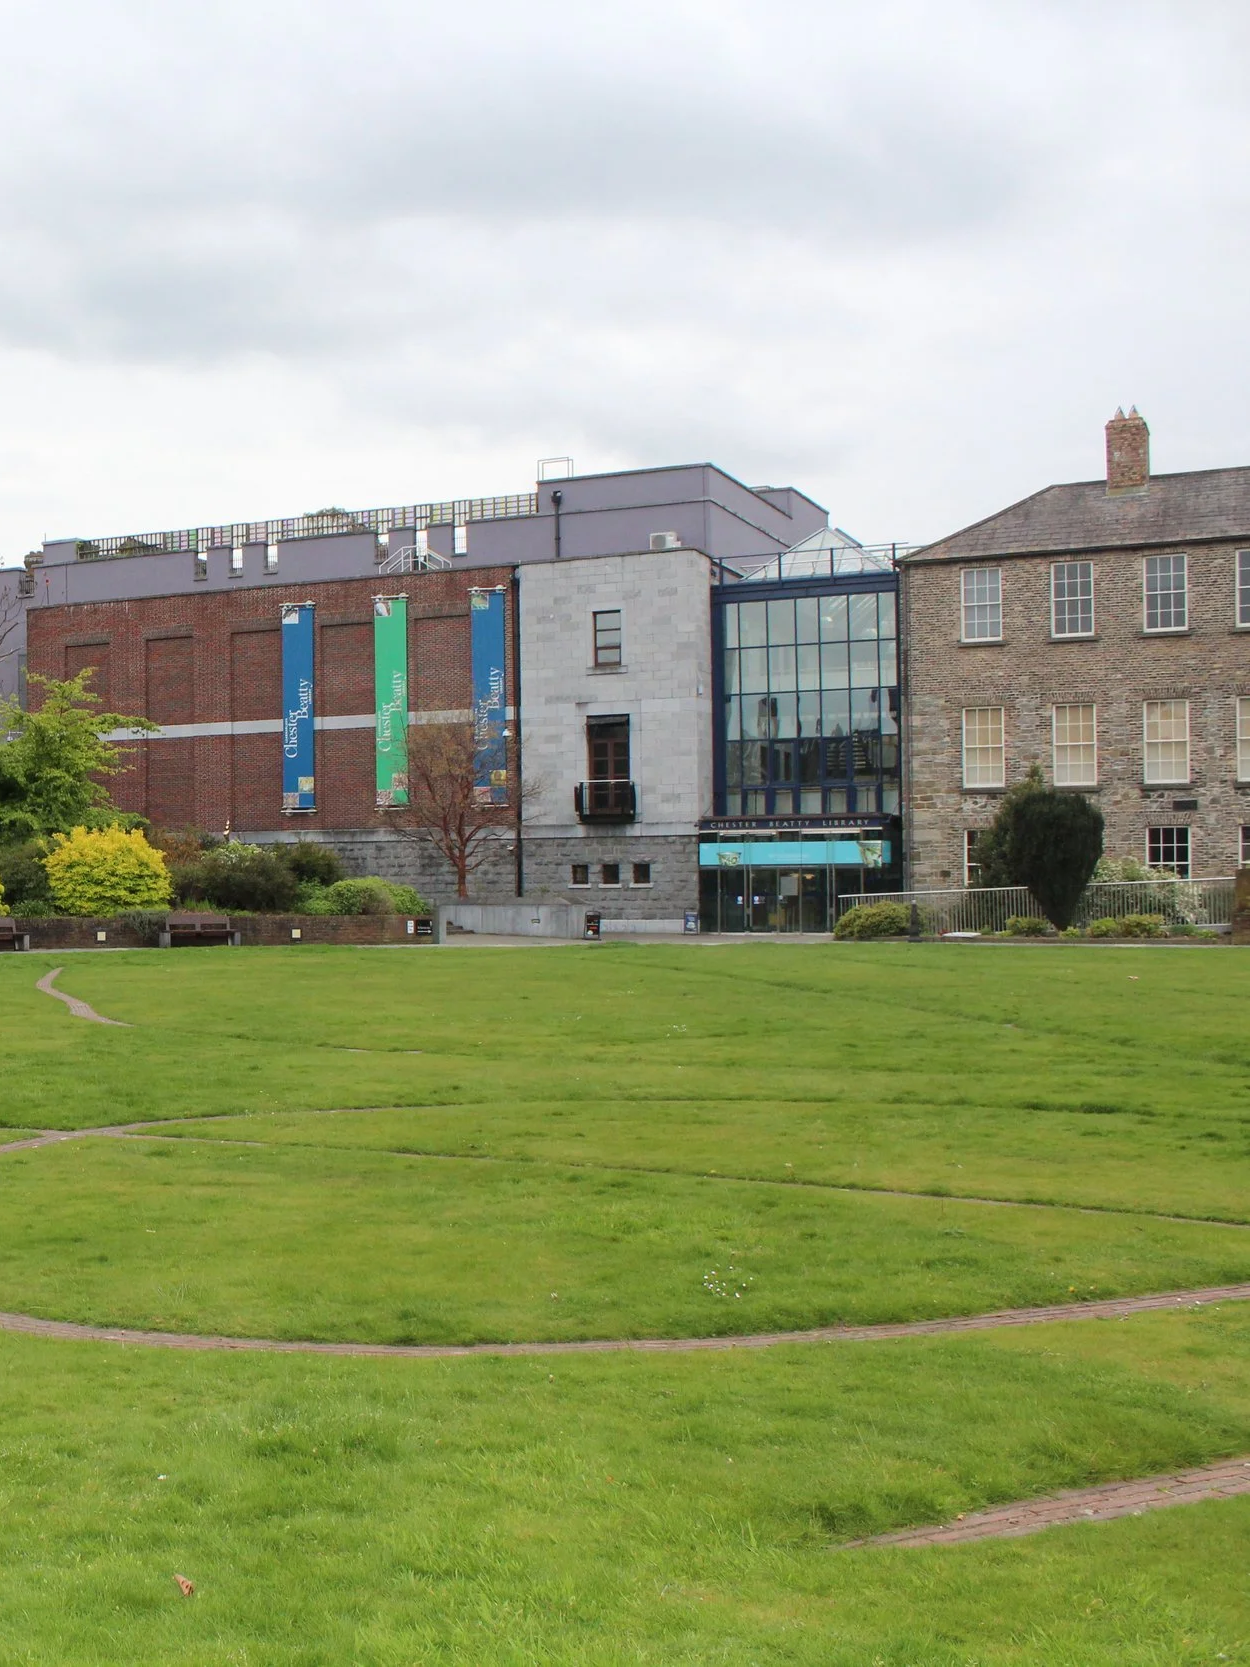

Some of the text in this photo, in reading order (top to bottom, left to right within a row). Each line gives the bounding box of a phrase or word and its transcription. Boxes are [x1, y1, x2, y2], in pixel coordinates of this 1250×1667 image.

[297, 678, 313, 719] Beatty
[390, 670, 407, 711] Beatty
[489, 667, 504, 709] Beatty
[283, 709, 298, 758] Chester
[376, 702, 391, 752] Chester
[710, 821, 757, 829] CHESTER
[769, 820, 810, 828] BEATTY
